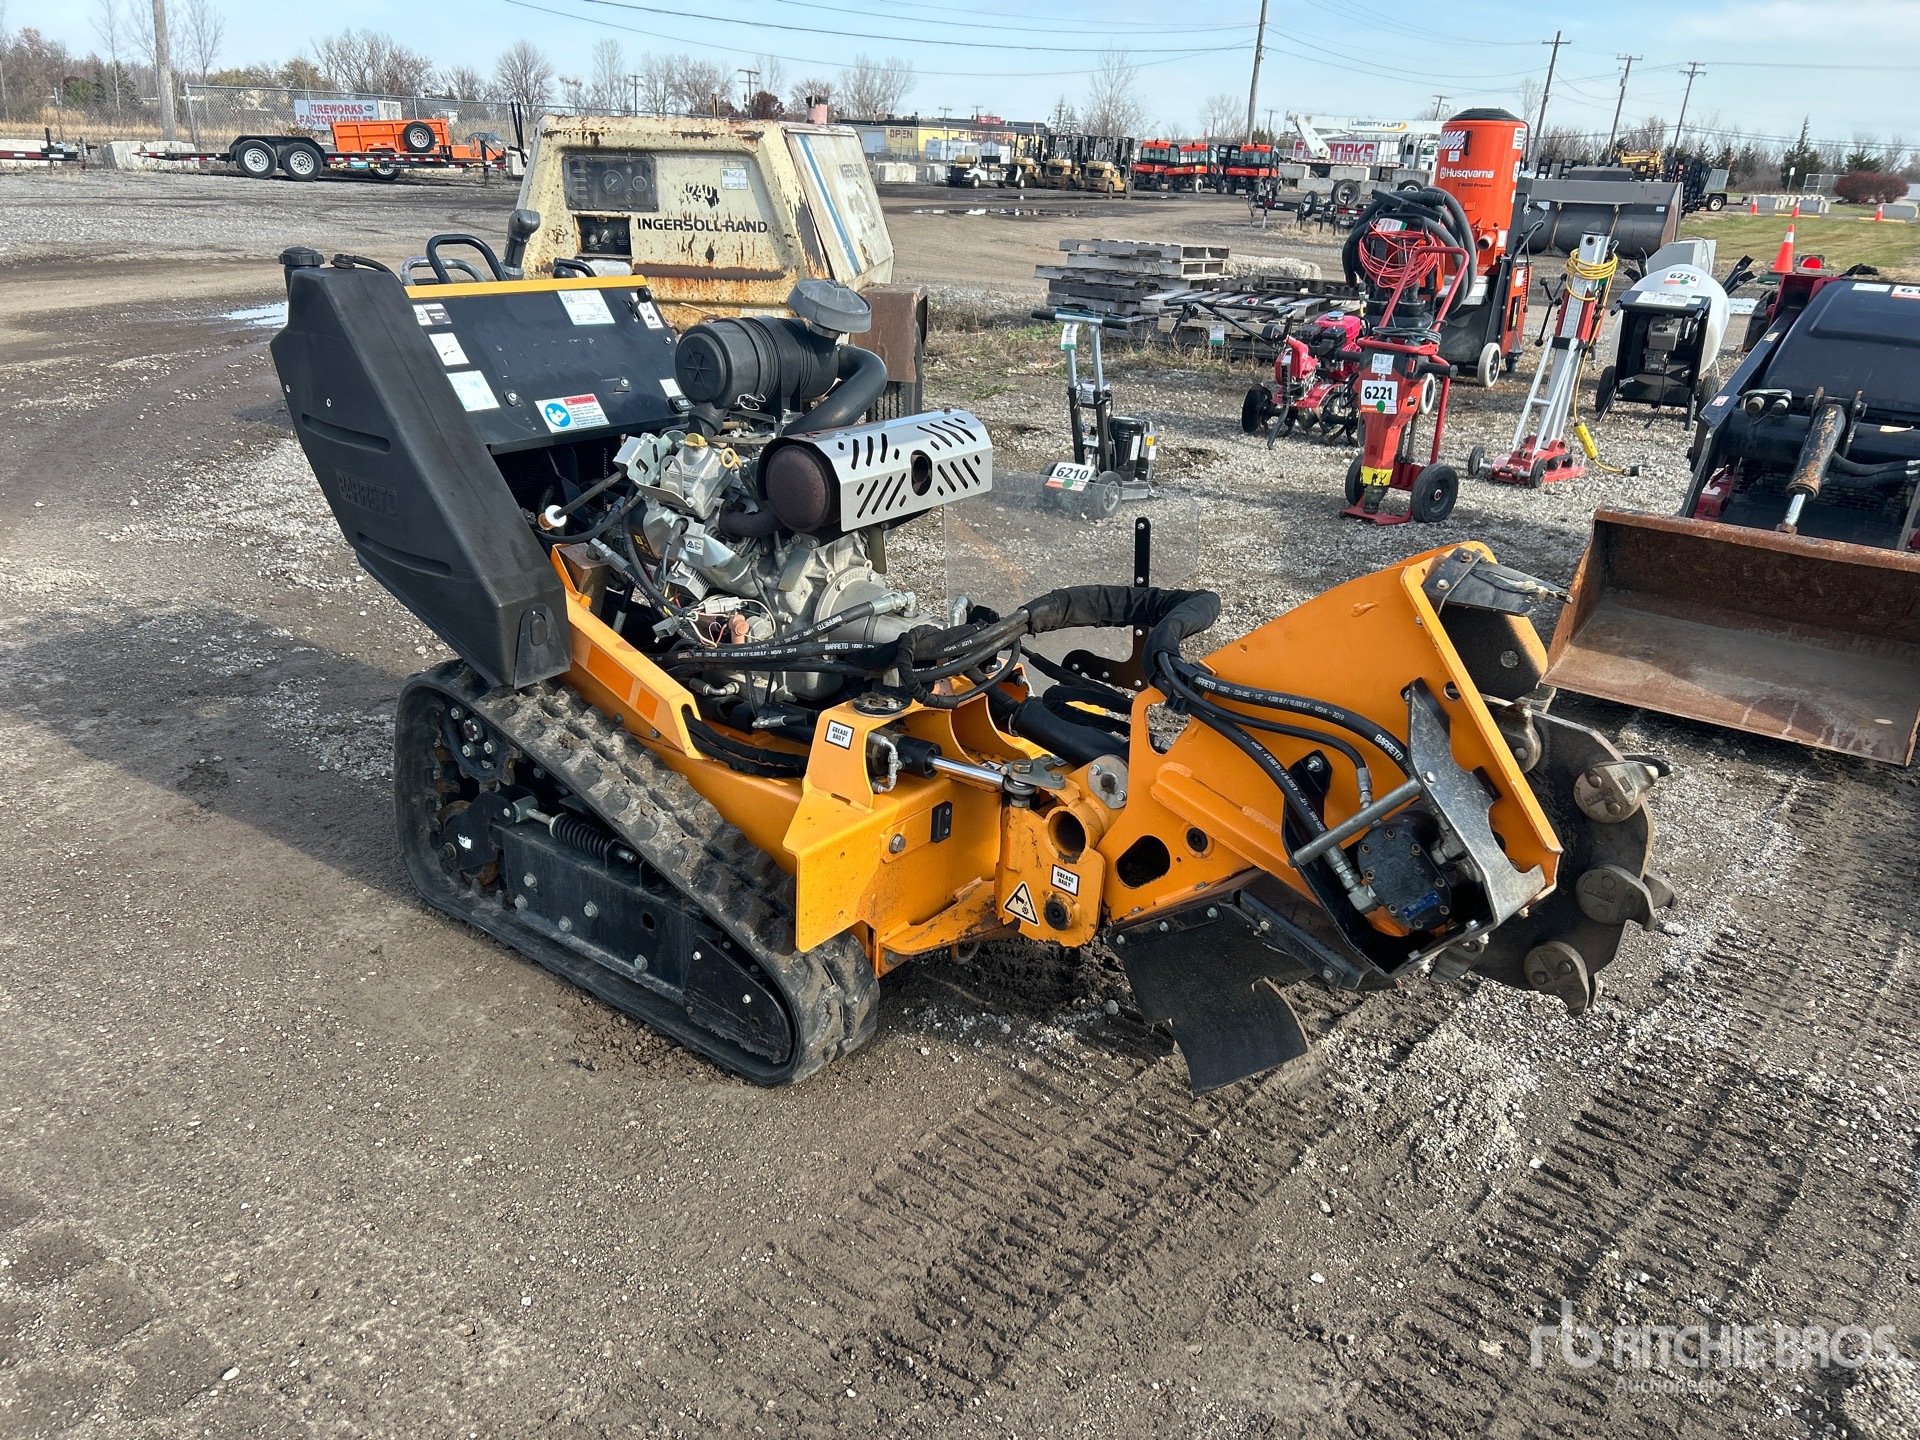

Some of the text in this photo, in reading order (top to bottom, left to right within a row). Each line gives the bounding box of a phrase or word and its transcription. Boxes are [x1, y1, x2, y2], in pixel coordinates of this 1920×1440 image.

[889, 129, 913, 139] OPEN
[1446, 169, 1495, 179] Husqvarna
[637, 218, 768, 234] INGERSOLL-RAND
[1669, 272, 1697, 282] 6226
[1364, 386, 1393, 400] 6221
[1056, 466, 1089, 480] 6210
[337, 471, 397, 515] BARRETO
[817, 614, 843, 631] BARRETO
[824, 643, 848, 651] BARRETO
[1314, 705, 1328, 714] MSHA
[832, 726, 848, 737] GREASE
[832, 733, 845, 742] DAILY
[1374, 733, 1404, 761] BARRETO
[1057, 871, 1074, 883] GREASE
[1058, 877, 1071, 888] DAILY
